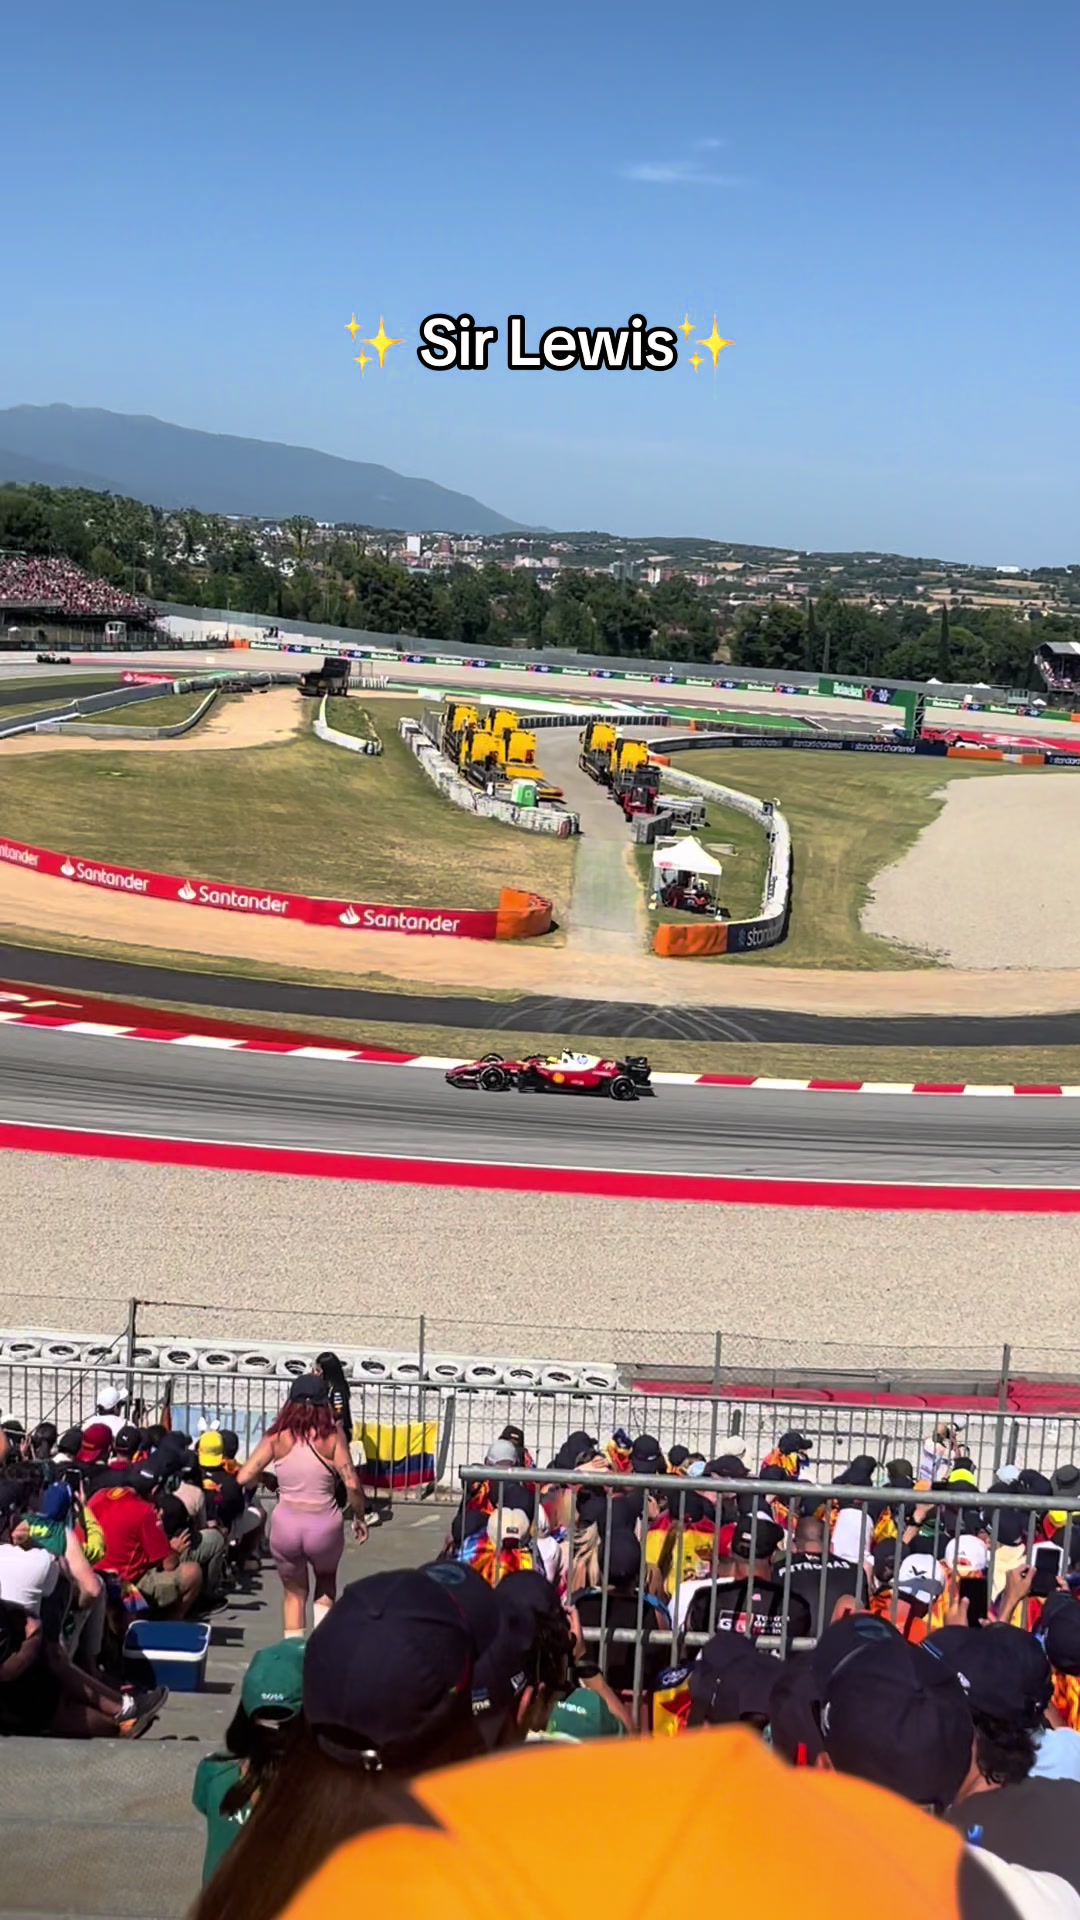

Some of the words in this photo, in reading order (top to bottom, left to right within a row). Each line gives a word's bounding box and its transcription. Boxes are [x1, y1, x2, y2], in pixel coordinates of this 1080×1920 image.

[76, 862, 150, 892] Santander
[199, 886, 289, 913] Santander
[363, 909, 460, 933] Santander
